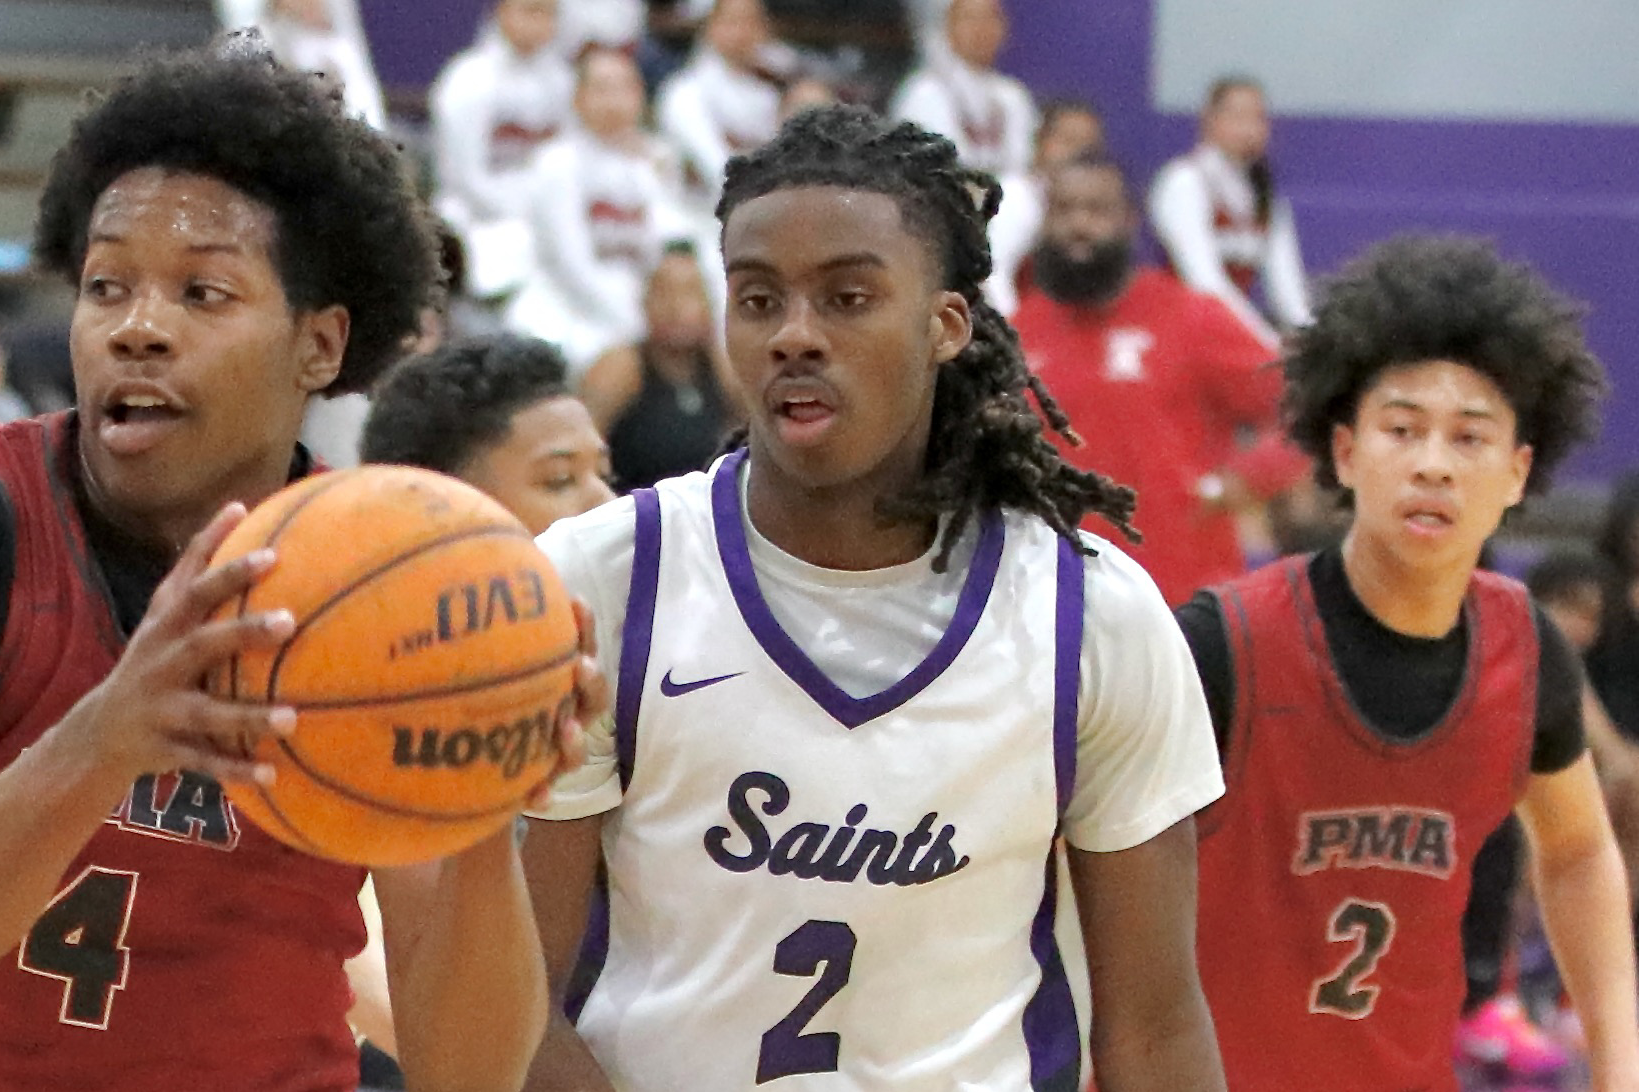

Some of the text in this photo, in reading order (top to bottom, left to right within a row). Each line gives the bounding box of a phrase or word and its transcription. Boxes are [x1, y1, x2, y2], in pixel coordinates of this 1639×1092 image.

[704, 771, 970, 887] Saints
[1291, 805, 1457, 880] PMA
[19, 865, 139, 1031] 4
[755, 919, 858, 1086] 2
[1310, 898, 1396, 1020] 2
